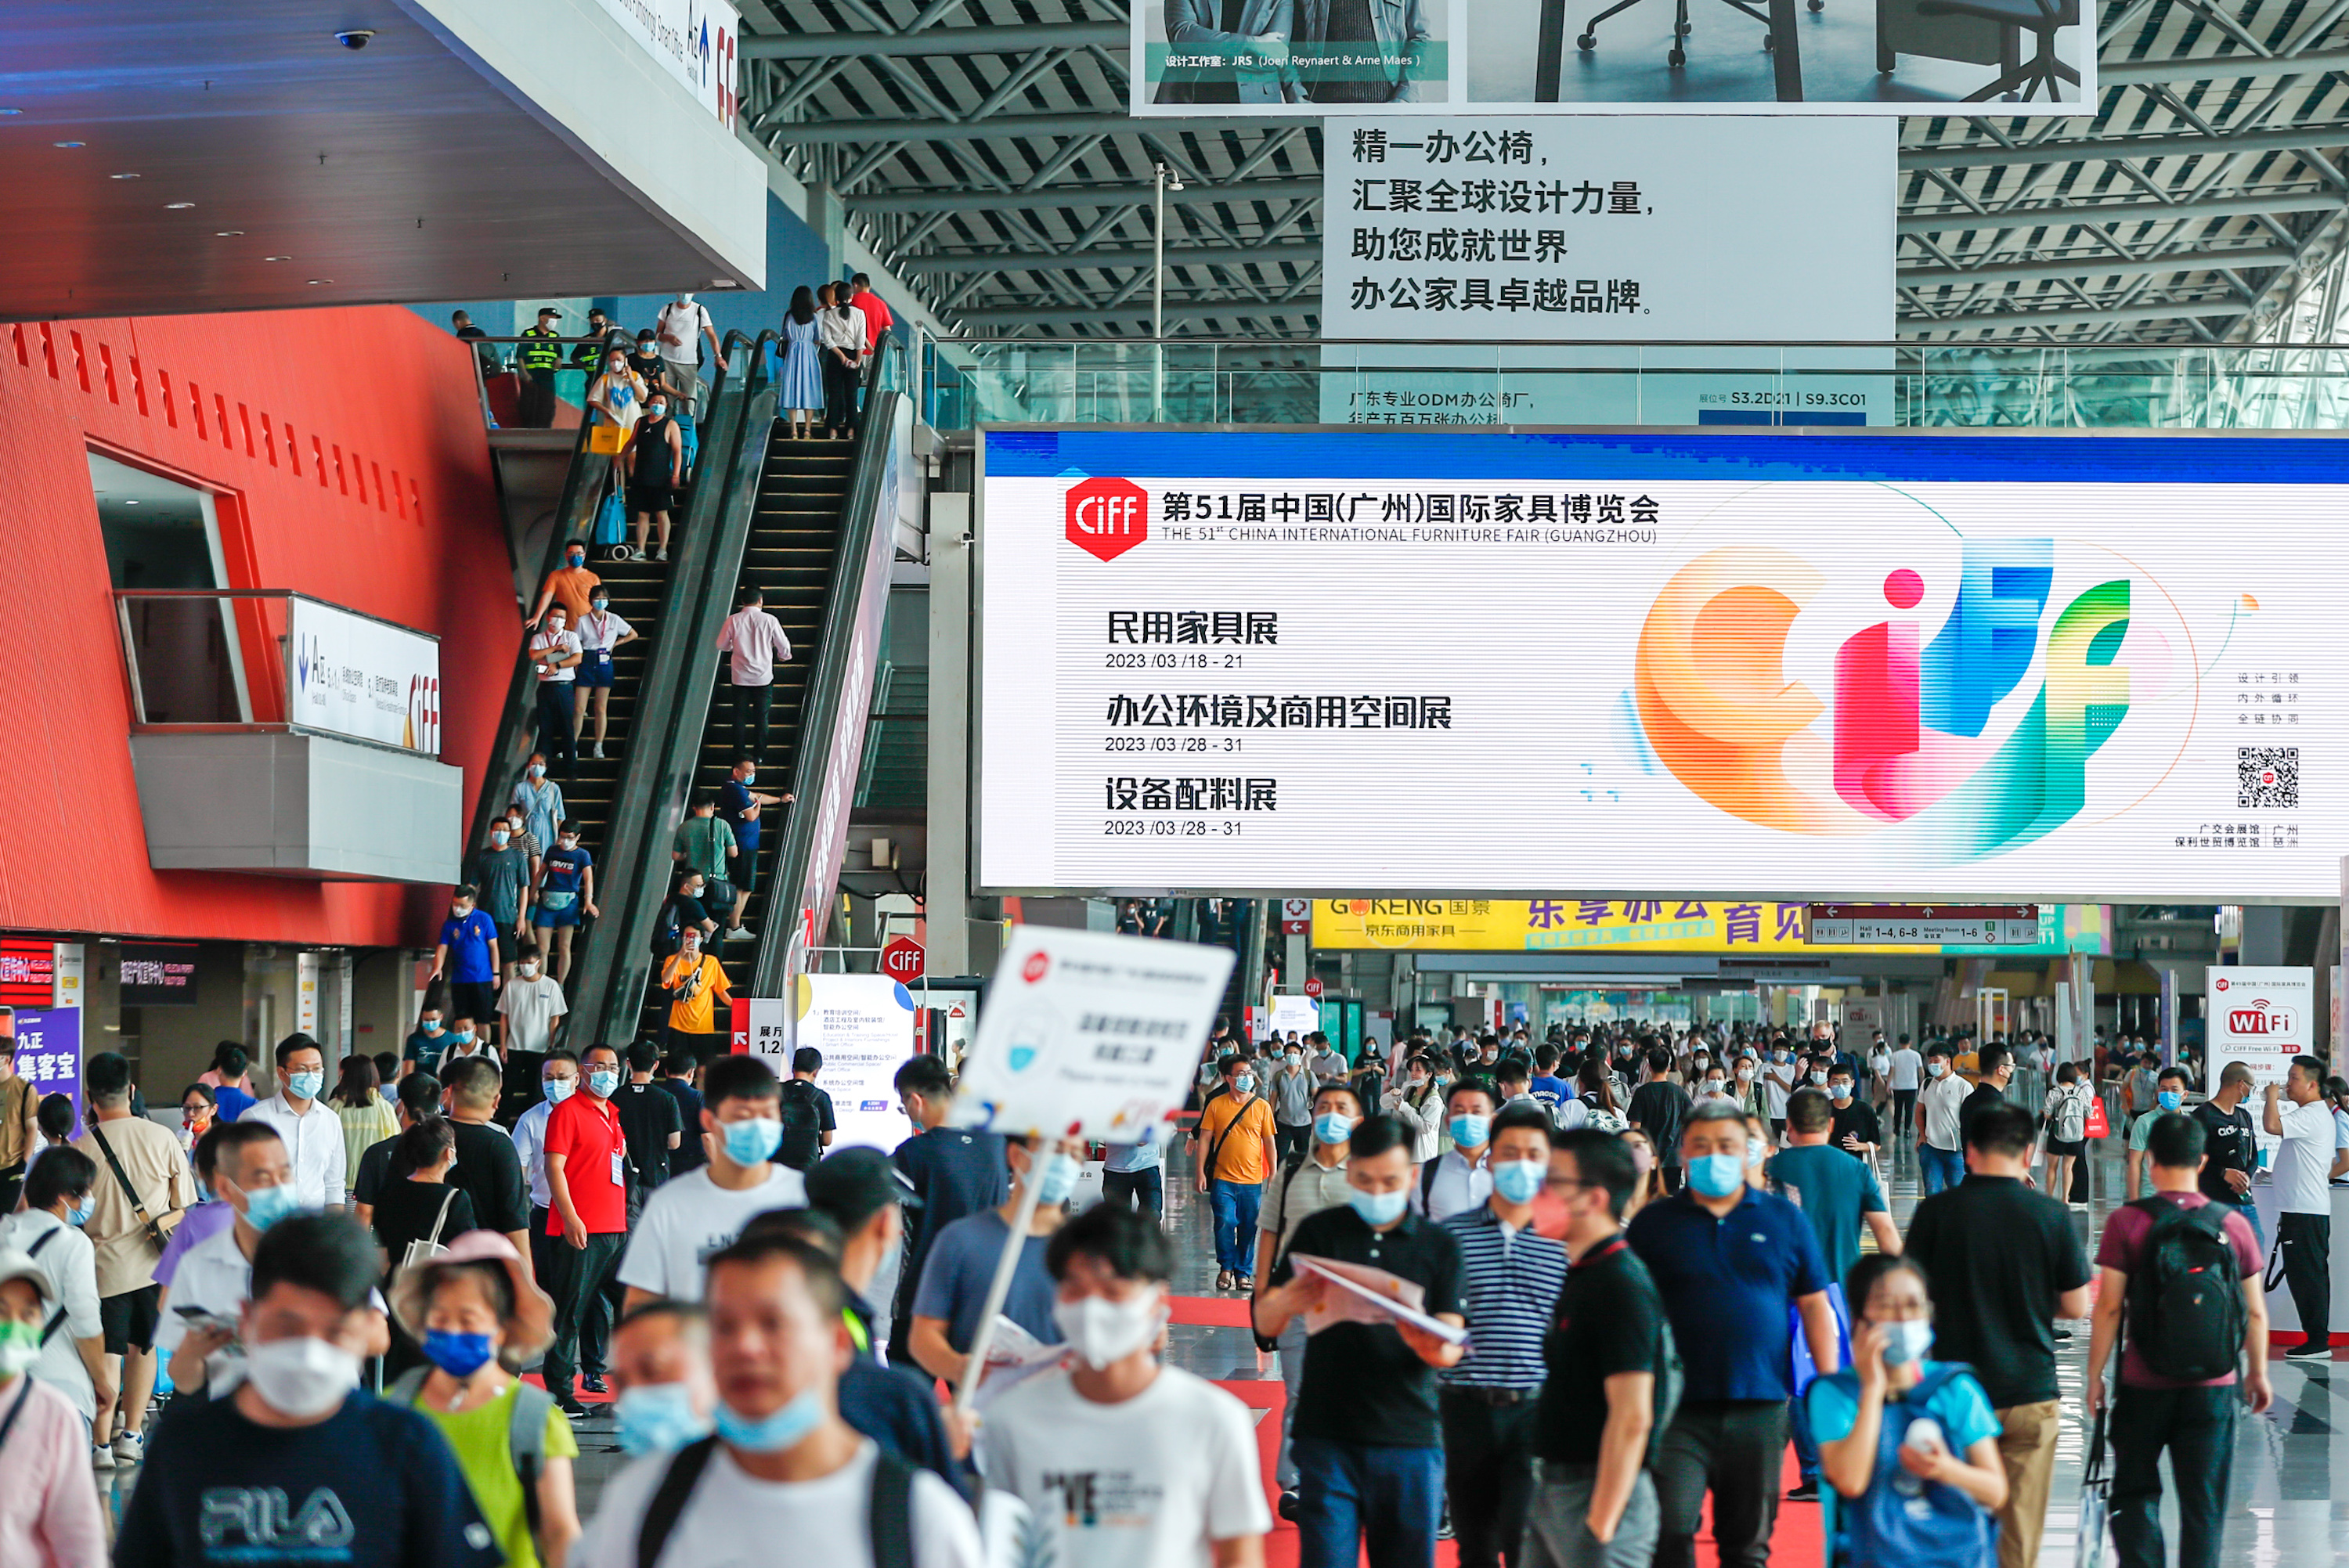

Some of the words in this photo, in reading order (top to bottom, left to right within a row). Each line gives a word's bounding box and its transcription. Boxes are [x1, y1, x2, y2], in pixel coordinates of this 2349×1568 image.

[1232, 56, 1253, 67] JRS
[1291, 56, 1340, 68] Reynaert
[1342, 56, 1352, 66] &
[1355, 56, 1381, 67] Arne
[1384, 56, 1413, 67] Maes
[1351, 227, 1568, 265] 助您成就世界
[1350, 276, 1651, 315] 办公家具卓越品牌。
[1805, 393, 1867, 406] S9.3C01
[1162, 528, 1193, 541] THE
[1229, 528, 1277, 542] CHINA
[1283, 528, 1408, 542] INTERNATIONAL
[1413, 528, 1502, 542] FURNITURE
[1506, 528, 1541, 542] FAIR
[1544, 528, 1657, 545] (GUANGZHOU)
[1107, 611, 1279, 645] 民用家具展
[1106, 653, 1146, 669] 2023
[1150, 653, 1176, 669] /03
[1181, 653, 1207, 669] /18
[1225, 653, 1243, 669] 21
[1106, 694, 1452, 730] 办公环境及商用空间展
[1105, 737, 1146, 752] 2023
[1149, 737, 1176, 752] /03
[1180, 737, 1207, 752] /28
[1224, 737, 1243, 752] 31
[1105, 776, 1278, 812] 设备配料展
[1104, 820, 1145, 836] 2023
[1149, 820, 1175, 836] /03
[1180, 820, 1207, 836] /28
[1223, 820, 1242, 836] 31
[2272, 824, 2299, 836] 广州
[1365, 924, 1456, 937] 京东商用家具
[1899, 927, 1918, 937] 6-8
[1961, 927, 1978, 937] 1-6
[17, 1031, 44, 1051] 九正
[17, 1051, 75, 1083] 集客宝
